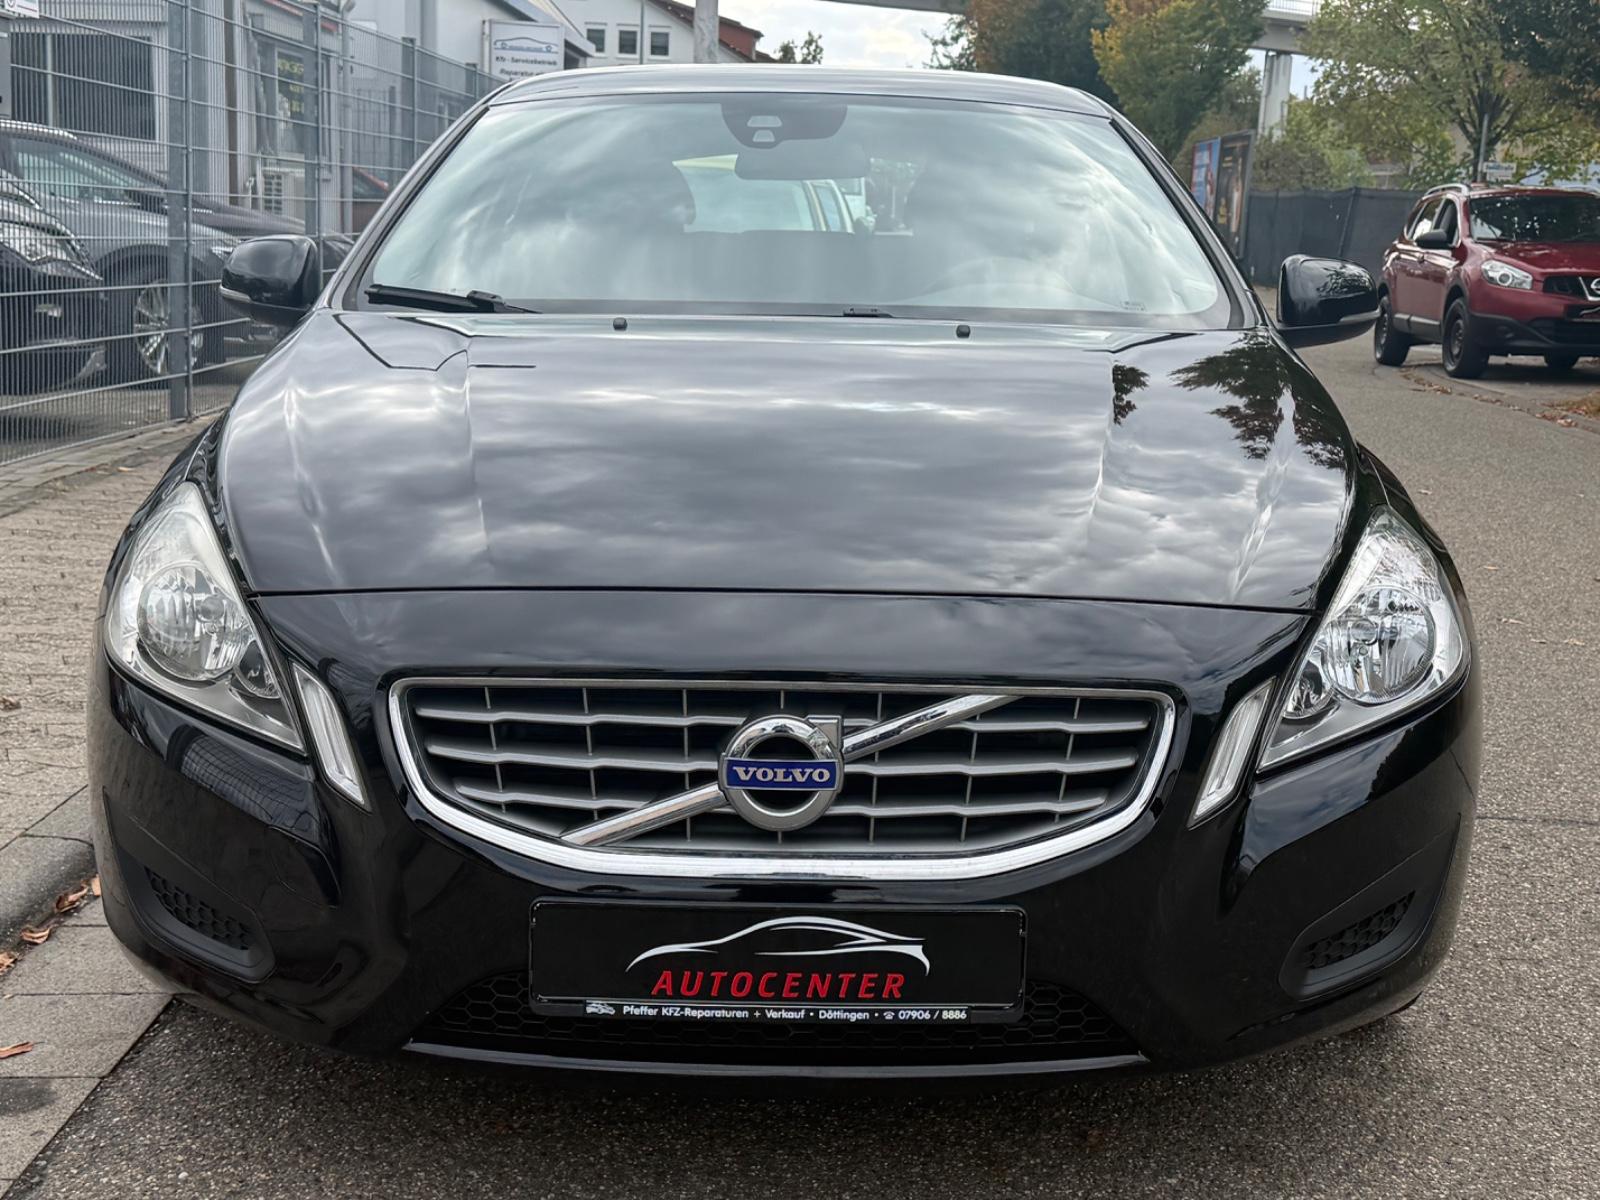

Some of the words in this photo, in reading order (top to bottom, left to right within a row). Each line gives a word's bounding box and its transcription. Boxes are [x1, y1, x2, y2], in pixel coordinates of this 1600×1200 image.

[732, 766, 831, 783] VOLVO
[651, 970, 905, 998] AUTOCENTER
[623, 1005, 659, 1016] Pfeffer
[661, 1006, 749, 1020] KFZ-Reparaturen
[753, 1010, 761, 1018] +
[764, 1009, 806, 1019] Verkauf
[818, 1009, 870, 1022] Döttingen
[898, 1009, 931, 1020] 07906
[941, 1009, 967, 1020] 8886
